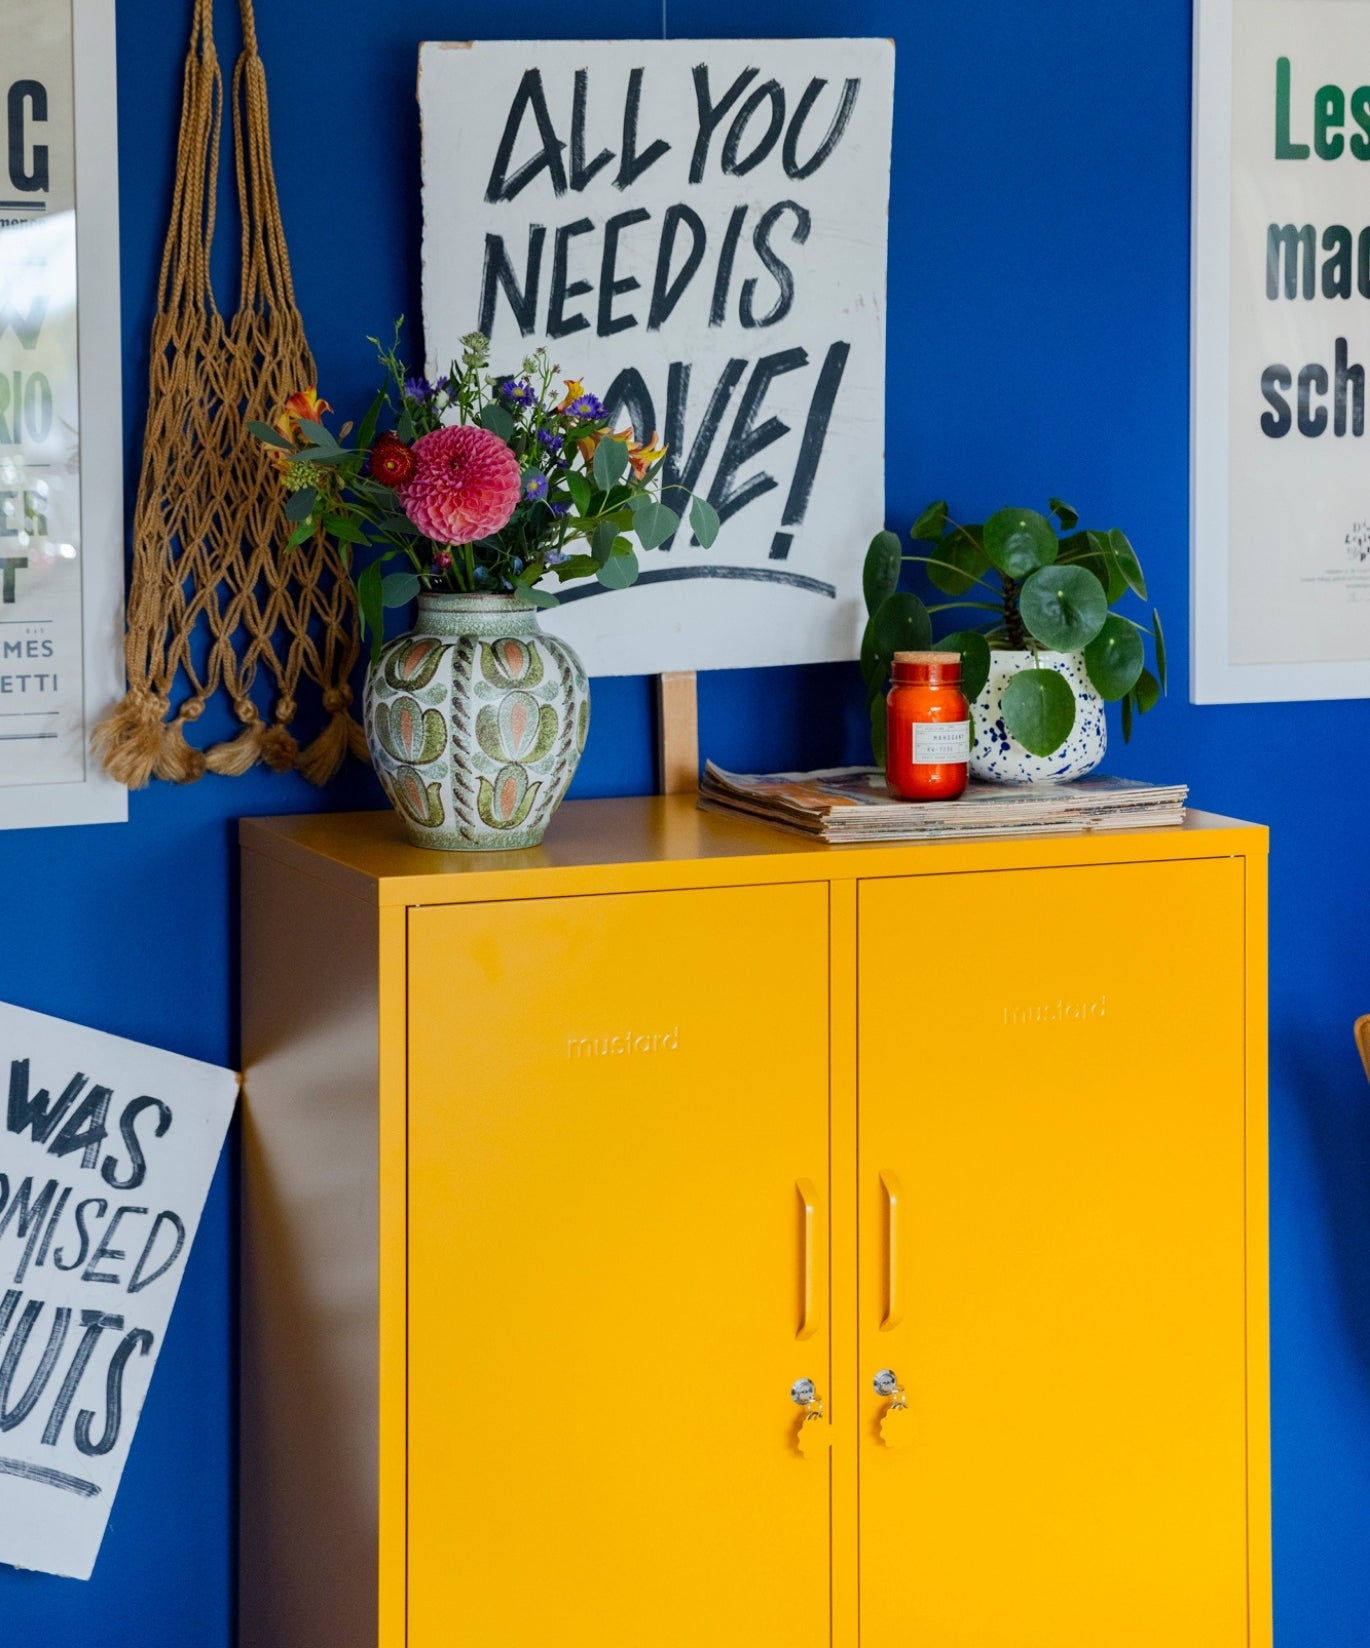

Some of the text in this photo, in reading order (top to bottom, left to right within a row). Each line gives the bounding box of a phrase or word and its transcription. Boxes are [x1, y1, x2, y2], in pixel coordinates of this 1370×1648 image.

[8, 79, 49, 192] G
[484, 63, 861, 203] ALL YOU
[478, 200, 812, 340] NEED IS
[1, 673, 58, 693] ETTI
[4, 640, 54, 658] MES
[566, 1025, 679, 1059] mustard
[1002, 994, 1107, 1025] mustard
[7, 1058, 172, 1189] WAS
